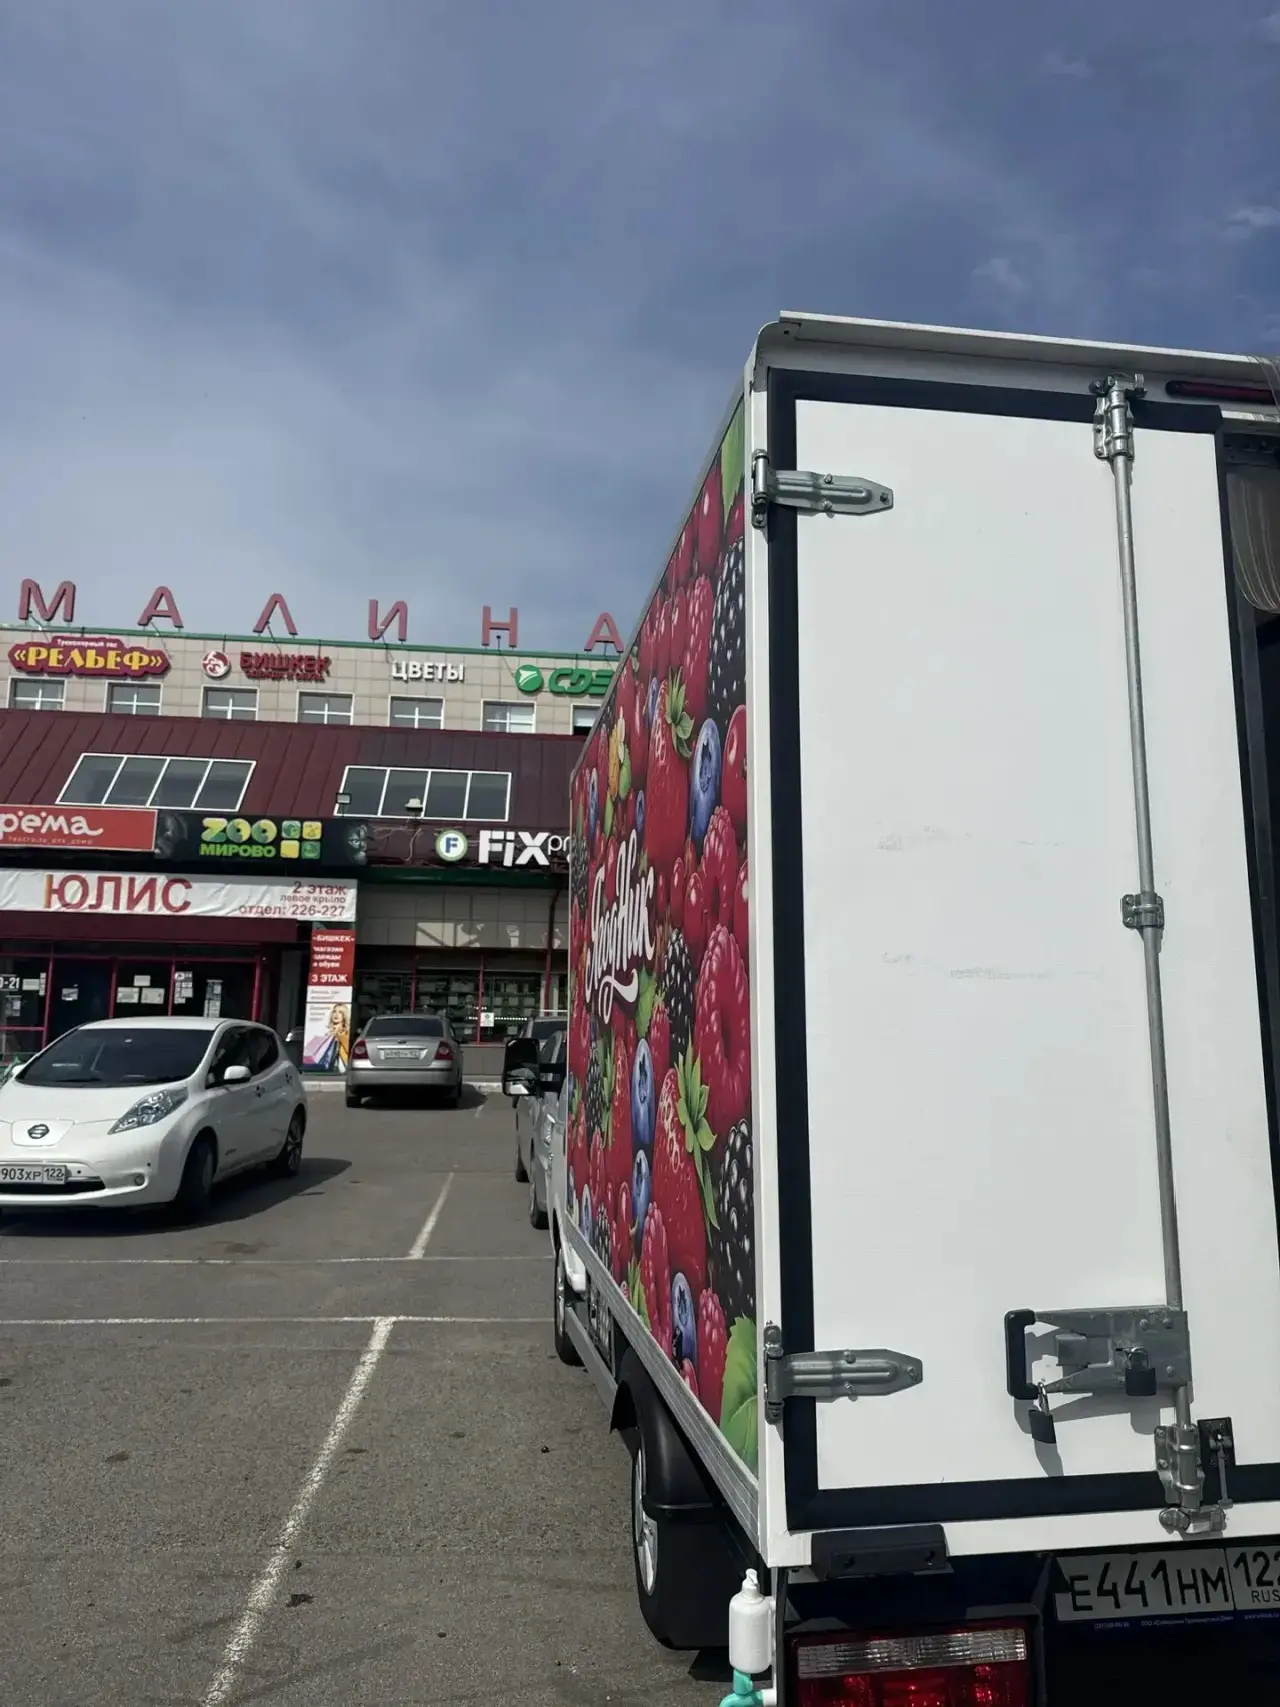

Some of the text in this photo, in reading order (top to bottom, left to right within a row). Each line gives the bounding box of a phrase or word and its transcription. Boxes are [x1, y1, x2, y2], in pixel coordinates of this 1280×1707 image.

[19, 578, 624, 653] МАЛИНА
[240, 652, 331, 674] БИШКЕК
[392, 659, 464, 681] ЦВЕТЫ
[201, 817, 278, 844] ZOO
[199, 843, 277, 858] МИРОВО
[44, 873, 193, 913] ЮЛИС
[293, 880, 347, 895] 2 этаж
[280, 894, 346, 904] левое крыло
[239, 903, 346, 917] отдел: 226-227
[311, 973, 347, 983] 3 ЭТАЖ
[44, 1168, 62, 1178] 122
[1251, 1590, 1280, 1604] RUS
